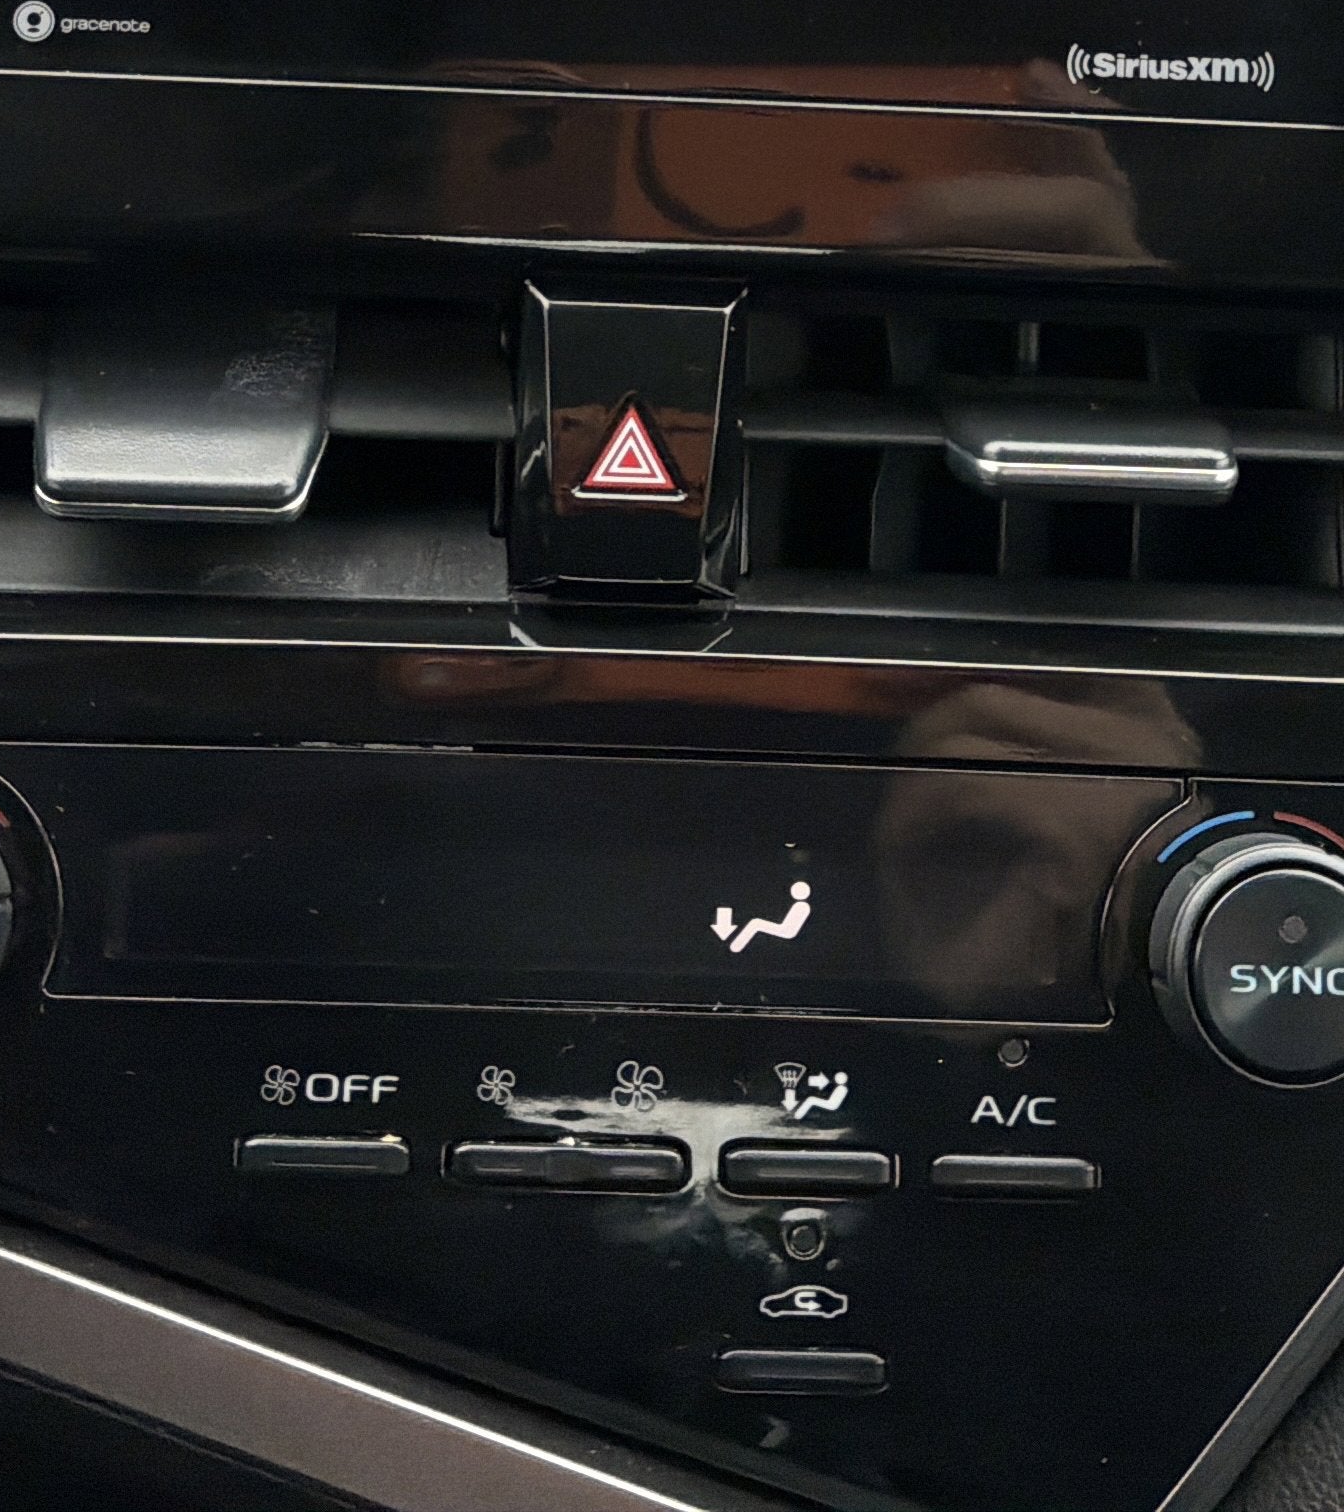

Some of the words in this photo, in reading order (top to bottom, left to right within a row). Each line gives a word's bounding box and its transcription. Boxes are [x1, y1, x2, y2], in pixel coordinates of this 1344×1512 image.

[60, 18, 151, 33] gracenote
[306, 1074, 400, 1104] OFF
[971, 1096, 1057, 1127] A/C
